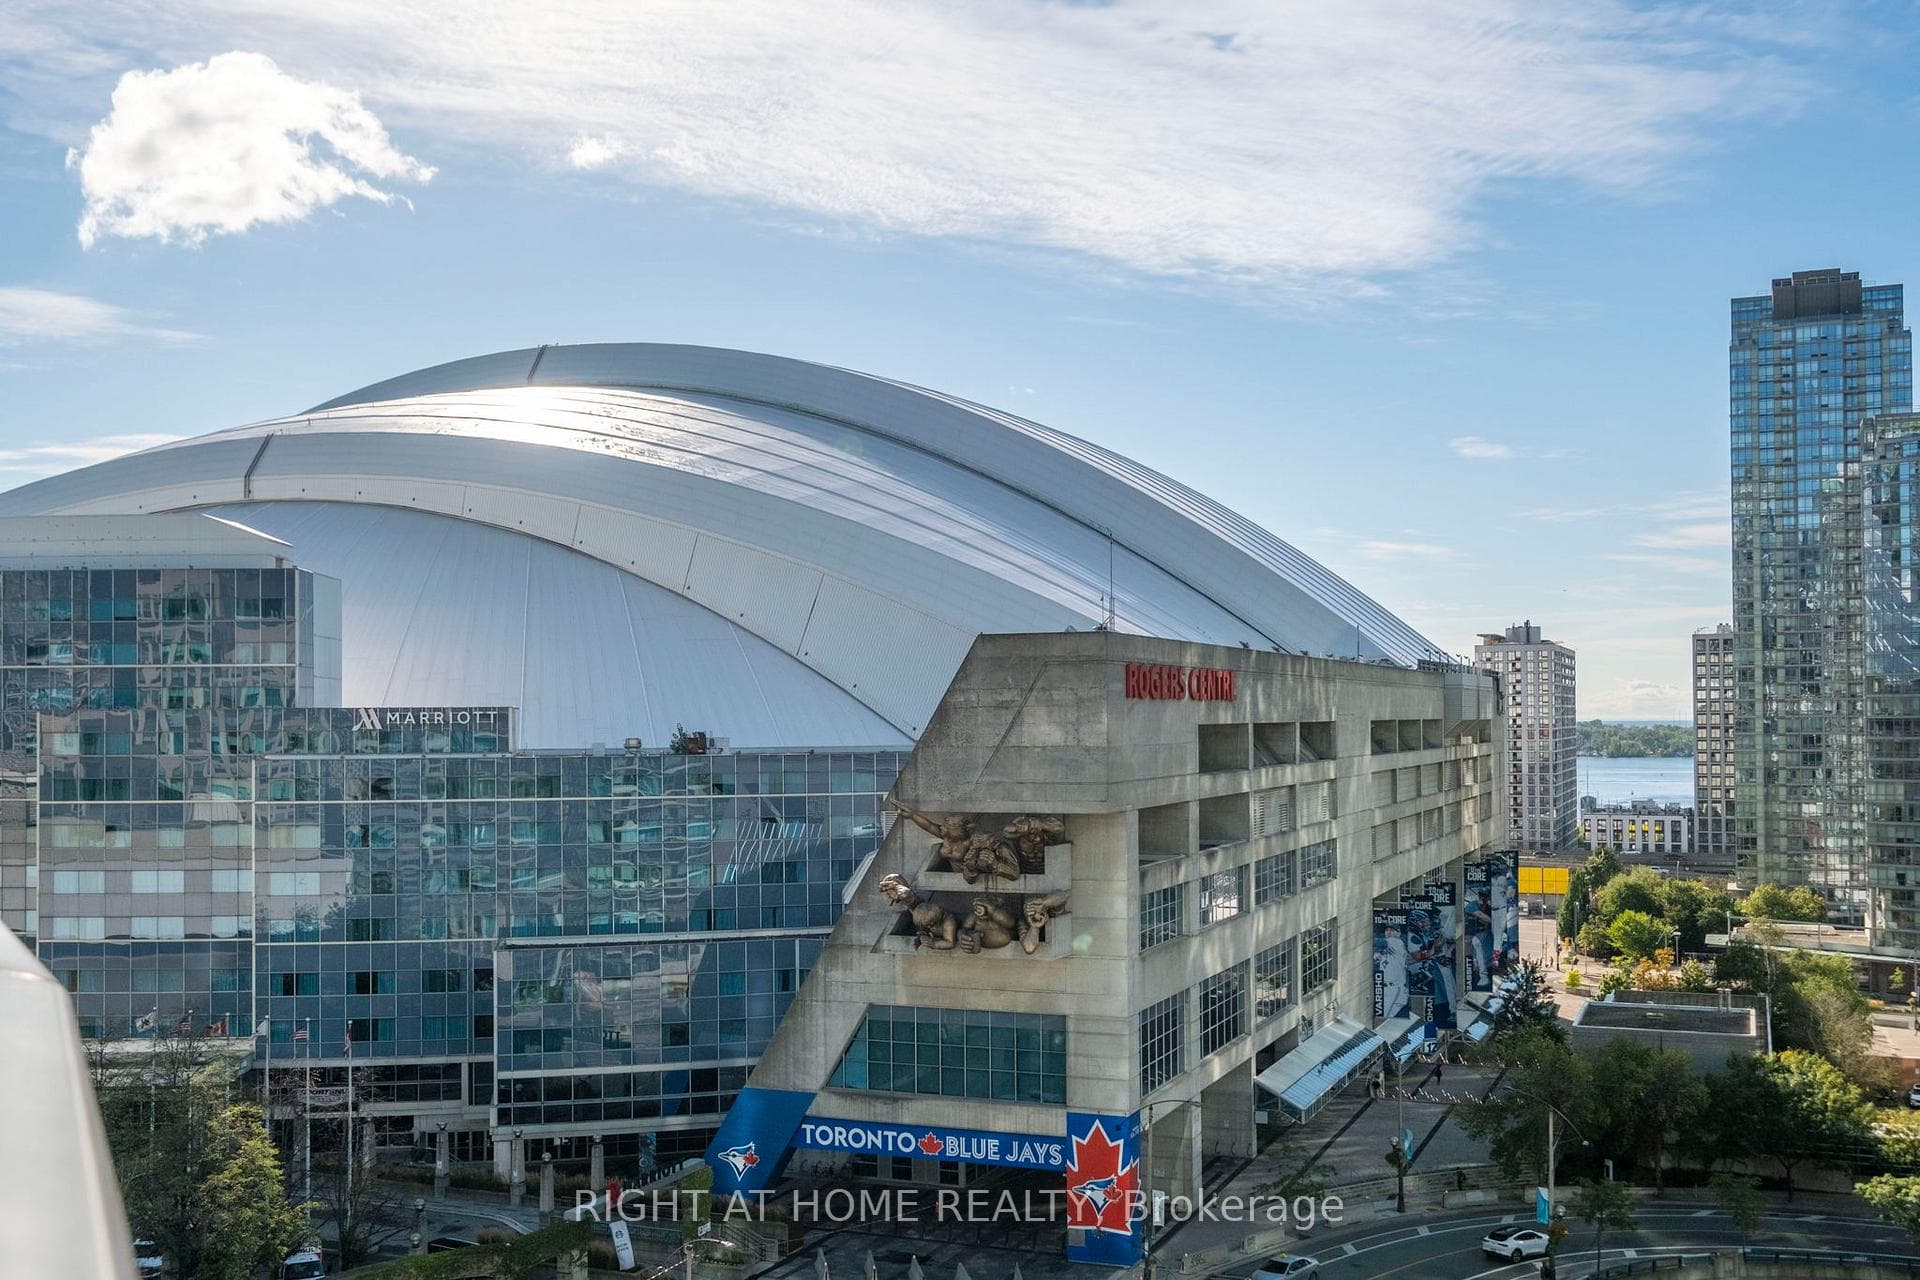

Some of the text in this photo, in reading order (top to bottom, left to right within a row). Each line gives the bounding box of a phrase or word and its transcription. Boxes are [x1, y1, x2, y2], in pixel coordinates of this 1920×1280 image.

[1125, 663, 1186, 699] ROGERS
[387, 711, 498, 725] MARRIOTT
[1430, 893, 1450, 904] ORE
[1387, 915, 1407, 925] CORE
[1375, 972, 1383, 1017] VARSHO
[801, 1124, 1063, 1167] TORONTO BLUE JAYS
